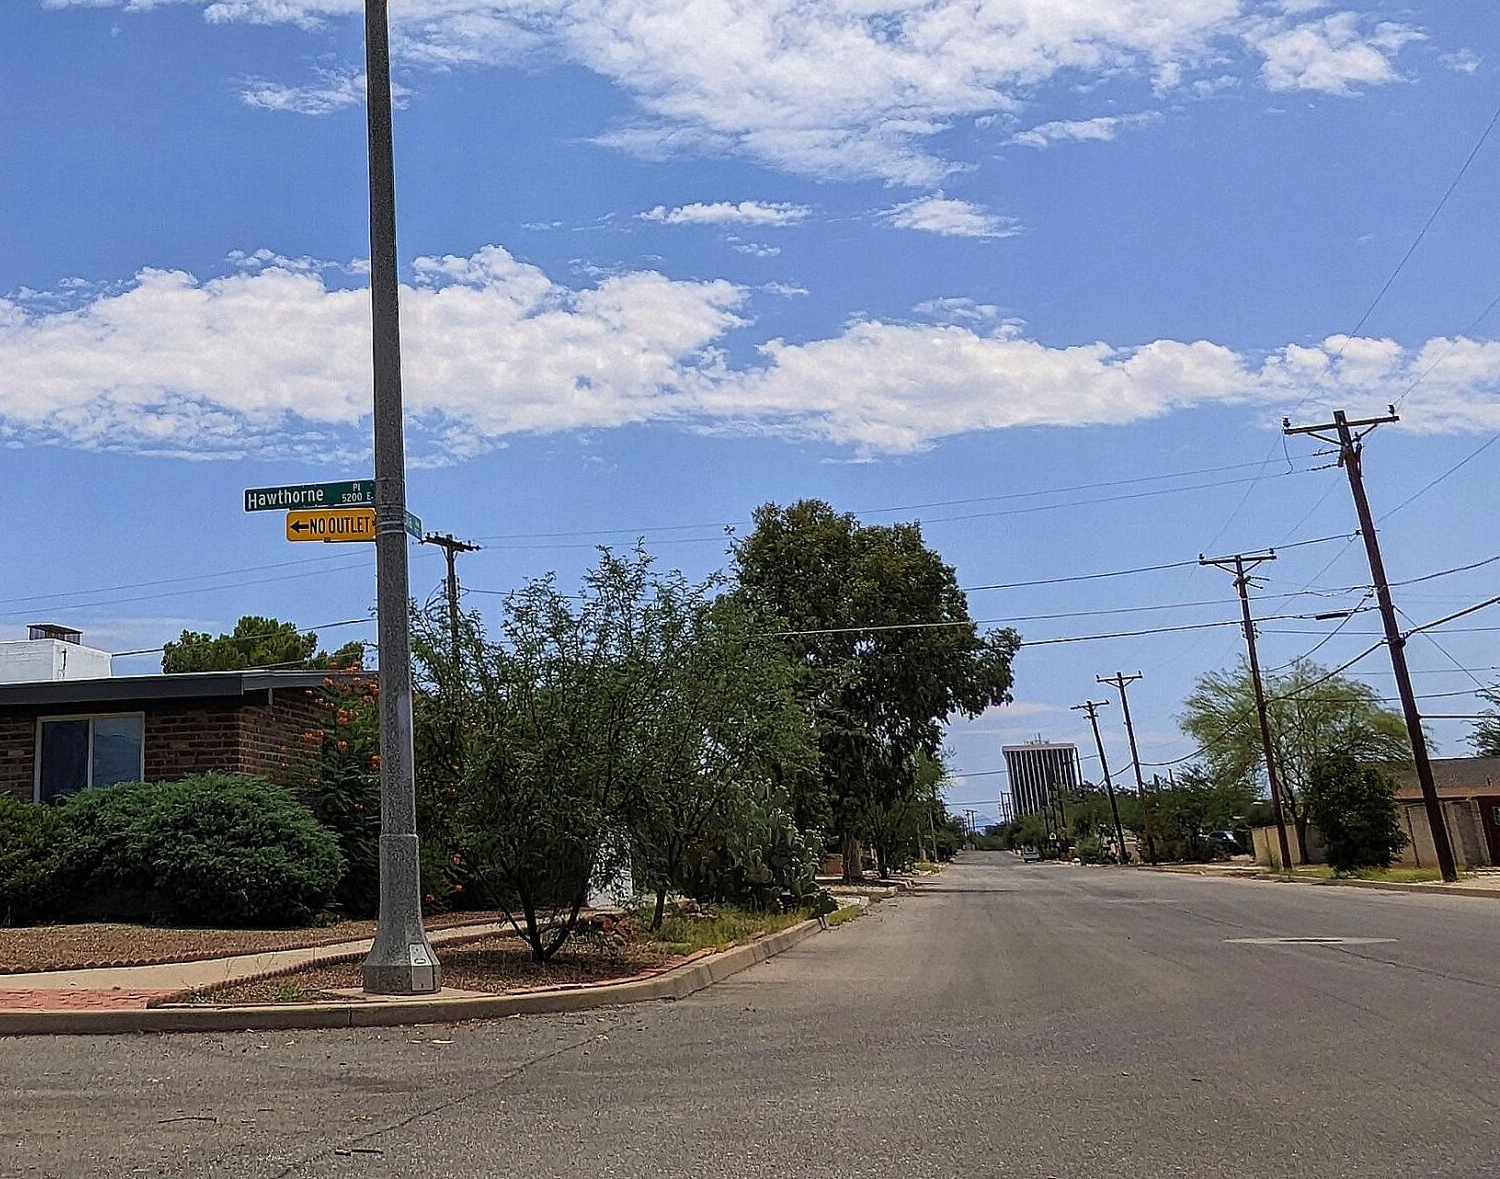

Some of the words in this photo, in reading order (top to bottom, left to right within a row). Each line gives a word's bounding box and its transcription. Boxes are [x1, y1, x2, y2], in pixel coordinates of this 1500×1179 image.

[248, 489, 324, 509] Hawthorne
[341, 492, 363, 502] 5200
[309, 517, 326, 535] NO
[328, 516, 371, 534] OUTLET
